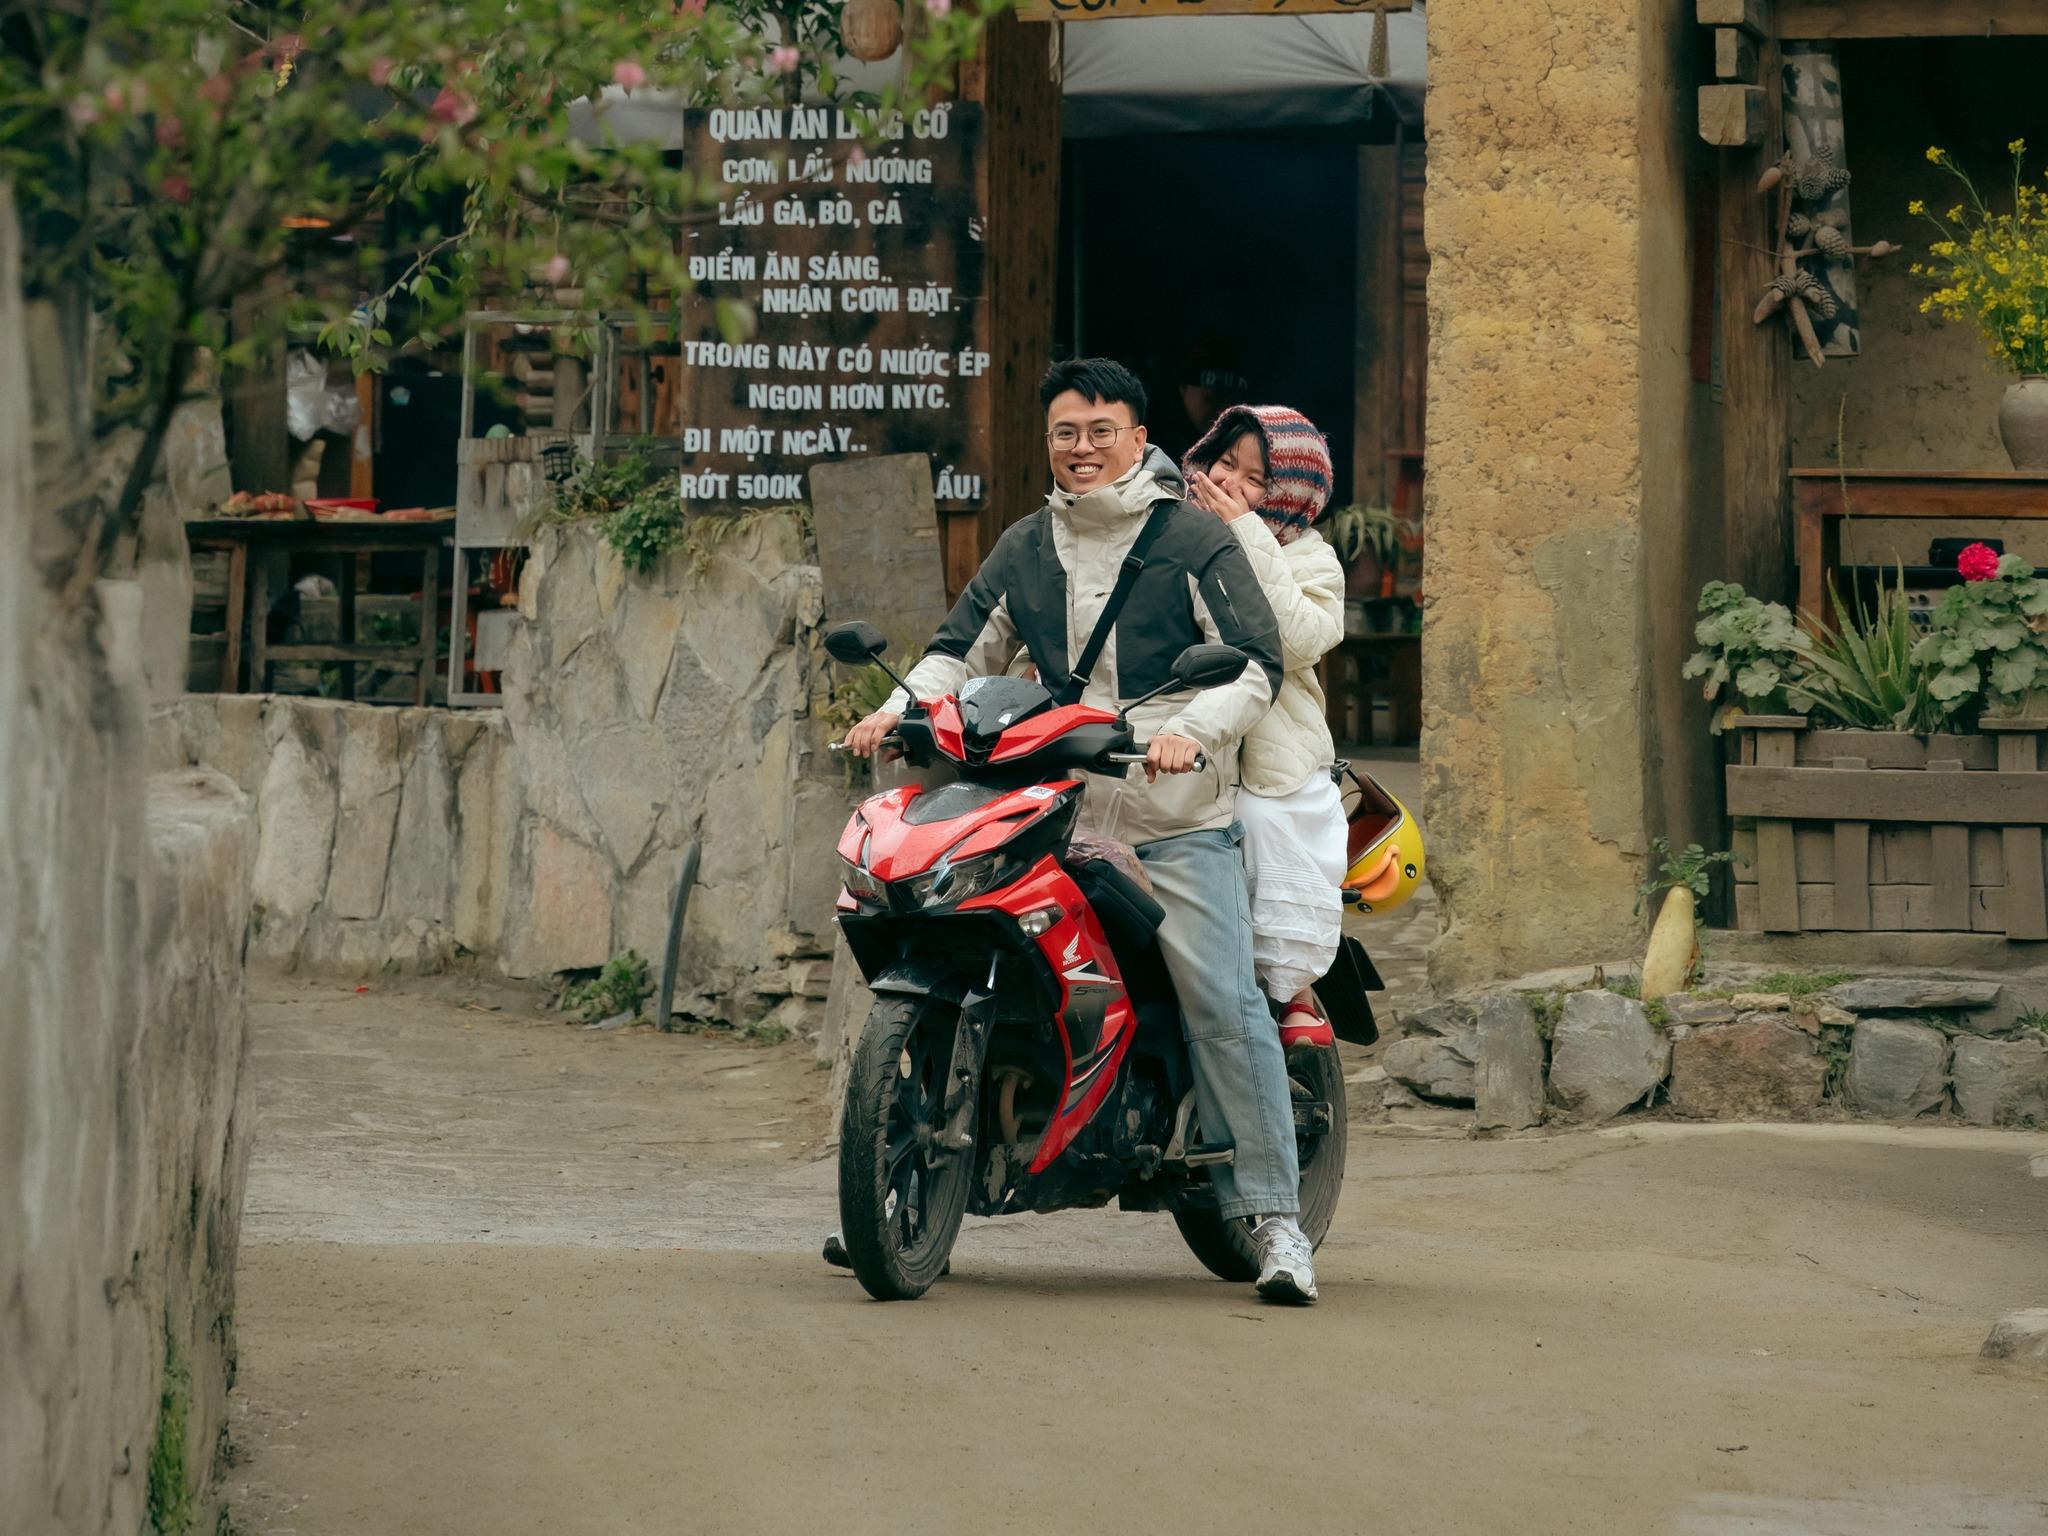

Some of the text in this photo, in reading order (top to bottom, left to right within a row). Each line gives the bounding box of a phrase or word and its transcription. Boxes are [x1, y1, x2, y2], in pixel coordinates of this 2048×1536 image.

[709, 106, 783, 143] QUÁN
[790, 103, 829, 139] ĂN
[913, 102, 953, 139] CỔ
[722, 147, 932, 184] CƠM LẨU NƯỚNG
[719, 191, 903, 229] LẨU GÀ, BÒ, CÁ
[689, 246, 756, 281] ĐIỂM
[763, 251, 800, 281] ĂN
[762, 282, 961, 319] NHẬN CƠM ĐẶT.
[684, 340, 991, 378] TRONG NÀY CÓ NƯỚC ÉP
[749, 382, 951, 410] NGON HƠN NYC.
[683, 427, 711, 453] ĐI
[720, 424, 775, 462] MỘT
[680, 464, 981, 500] RỚT 500K ẨU!
